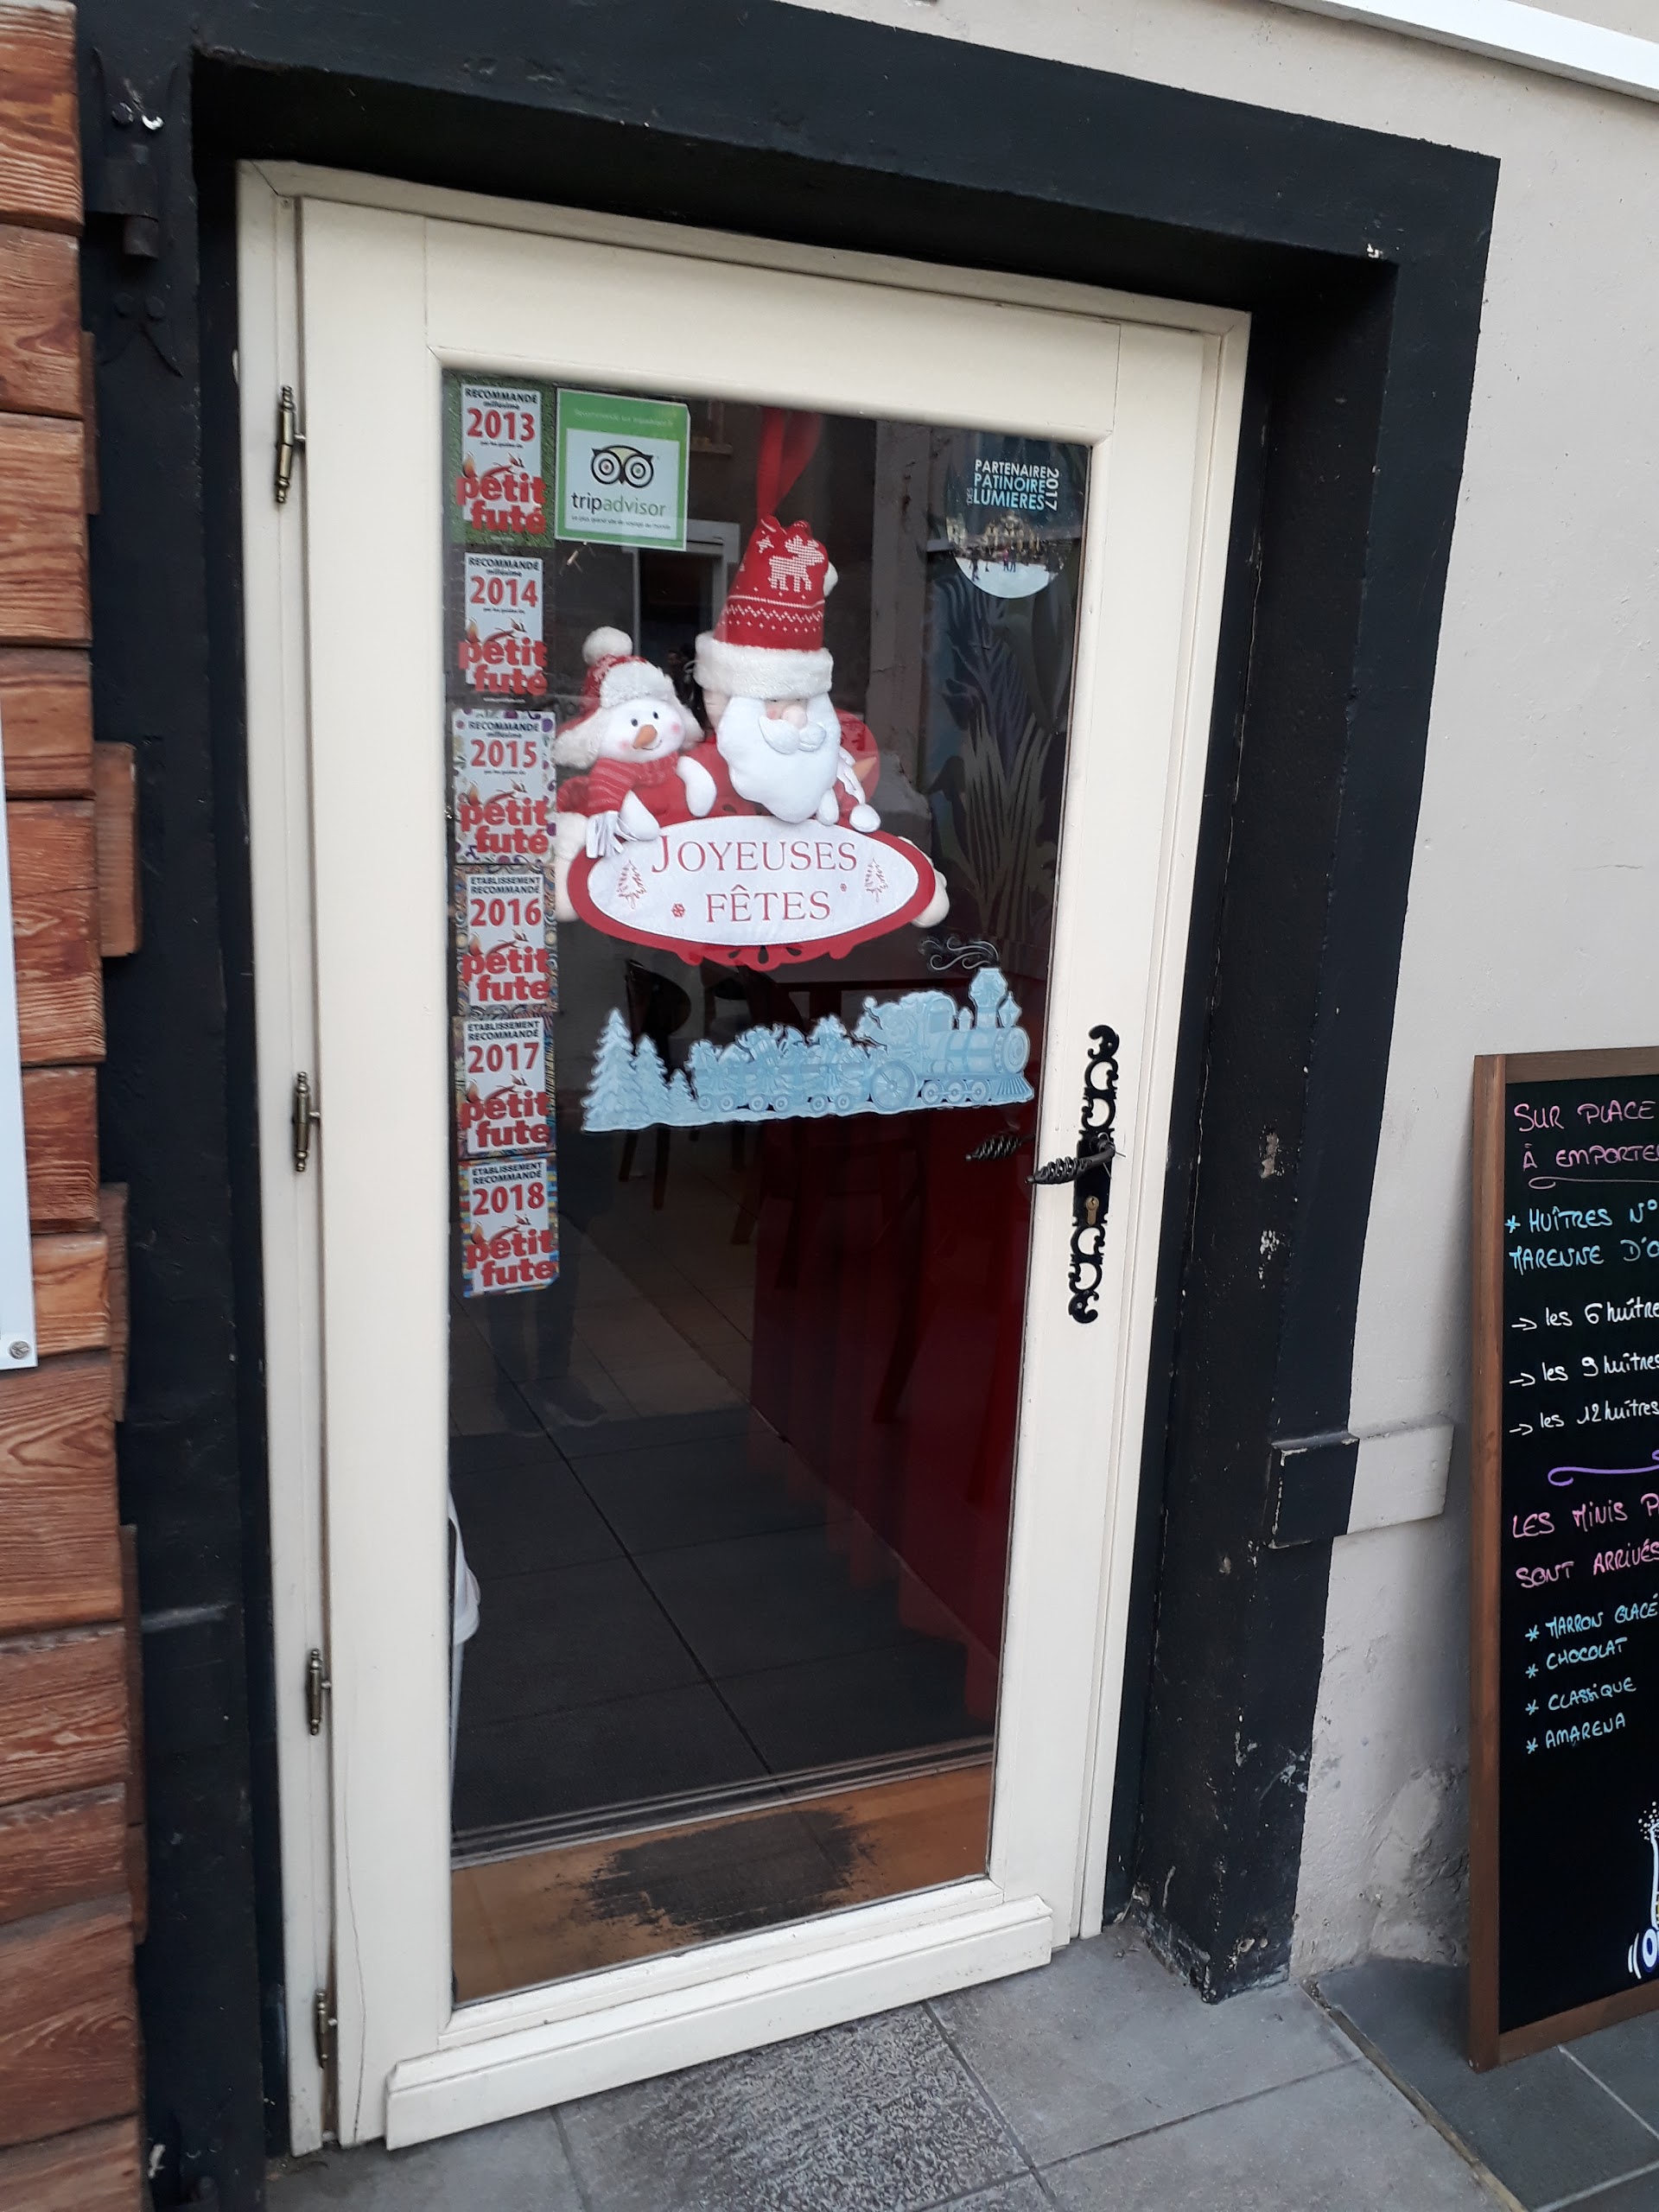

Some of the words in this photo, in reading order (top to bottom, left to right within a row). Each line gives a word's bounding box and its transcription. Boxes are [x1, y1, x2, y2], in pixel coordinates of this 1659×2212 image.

[467, 407, 535, 441] 2013
[974, 473, 1046, 493] PATINOIRE
[975, 459, 1046, 480] PARTENAIRE
[456, 473, 546, 505] petit
[571, 492, 666, 517] tripadvisor
[973, 488, 1046, 511] LUMIERES
[1046, 467, 1059, 512] 2017
[471, 500, 546, 534] futé
[470, 575, 538, 607] 2014
[457, 637, 548, 670] petit
[474, 664, 548, 696] futé
[470, 740, 537, 768] 2015
[460, 798, 549, 832] petit
[475, 825, 549, 855] futé
[652, 835, 858, 874] JOYEUSES
[470, 898, 542, 926] 2016
[705, 884, 831, 924] FÊTES
[461, 945, 550, 983] petit
[468, 1042, 540, 1073] 2017
[461, 1090, 550, 1129] petit
[1514, 1103, 1564, 1132] SUR
[1577, 1099, 1656, 1124] PLACE
[473, 1182, 545, 1216] 2018
[1529, 1205, 1613, 1233] HUÎTRES
[466, 1229, 556, 1269] petit
[1509, 1245, 1605, 1275] MARENNE
[1545, 1306, 1573, 1326] les
[1584, 1302, 1603, 1325] 6
[1541, 1362, 1568, 1382] les
[1581, 1357, 1599, 1377] 9
[1540, 1412, 1565, 1428] les
[1577, 1403, 1602, 1425] 12
[1605, 1399, 1659, 1421] huîtres
[1512, 1512, 1554, 1538] LES
[1516, 1560, 1574, 1588] SONT
[1545, 1611, 1604, 1639] MARRON
[1614, 1592, 1659, 1624] GLACÉ
[1546, 1637, 1628, 1670] CHOCOLAT
[1545, 1712, 1626, 1749] AMARENA
